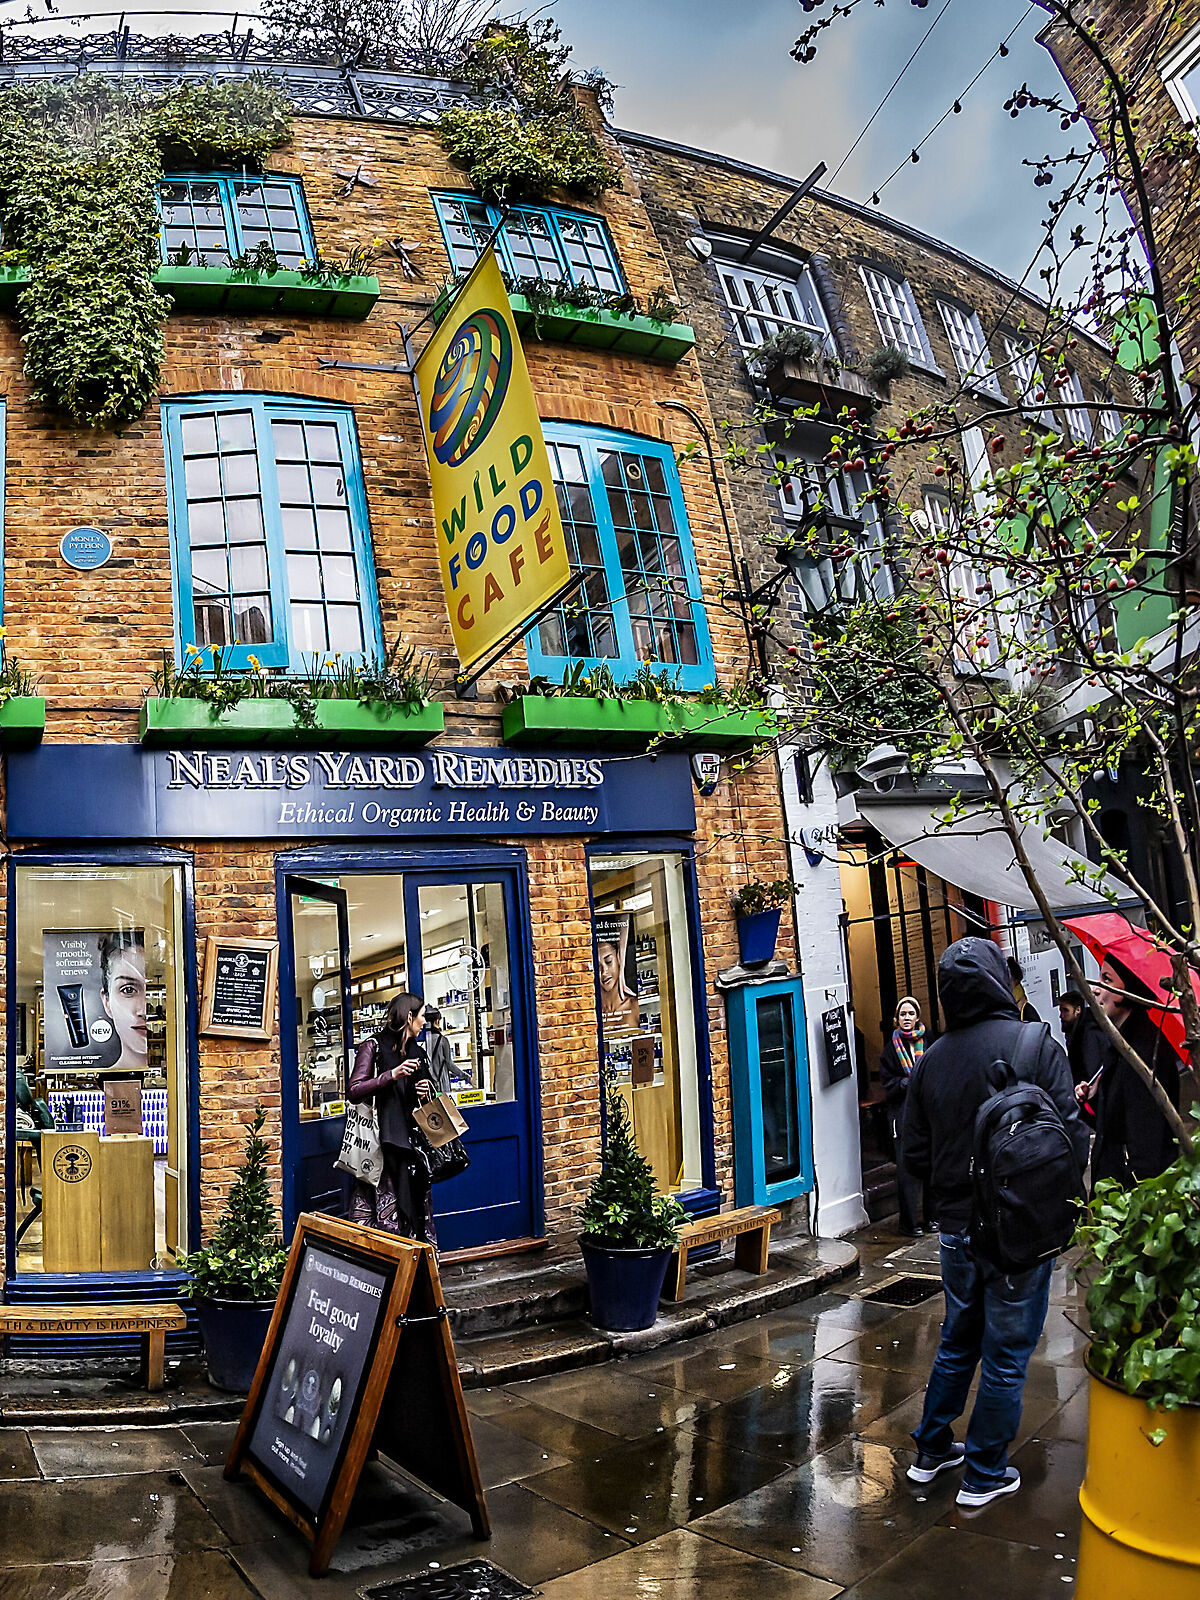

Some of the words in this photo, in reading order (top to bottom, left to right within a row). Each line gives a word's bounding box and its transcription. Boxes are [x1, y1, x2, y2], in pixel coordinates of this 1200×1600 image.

[441, 434, 534, 545] WILD
[448, 479, 543, 590] FOOD
[69, 542, 104, 550] PYTHON
[457, 507, 554, 631] CAFE
[167, 750, 311, 789] NEAL'S
[315, 751, 426, 788] YARD
[430, 753, 605, 788] REMEDIES
[278, 802, 355, 824] Ethical
[362, 801, 442, 828] Organic
[447, 801, 510, 822] Health
[516, 801, 536, 822] &
[541, 801, 599, 825] Beauty
[56, 950, 93, 959] smooths,
[60, 940, 88, 950] Visibly
[55, 959, 84, 967] softens
[85, 958, 93, 967] &
[60, 967, 89, 976] renews
[111, 1100, 130, 1109] 91%
[358, 1115, 374, 1130] YOU,
[348, 1275, 382, 1299] REMEDIES
[307, 1288, 331, 1316] Feel
[329, 1306, 360, 1331] good
[25, 1322, 34, 1331] &
[39, 1321, 90, 1331] BEAUTY
[96, 1320, 106, 1330] IS
[110, 1318, 177, 1330] HAPPINESS
[308, 1316, 344, 1353] loyalty
